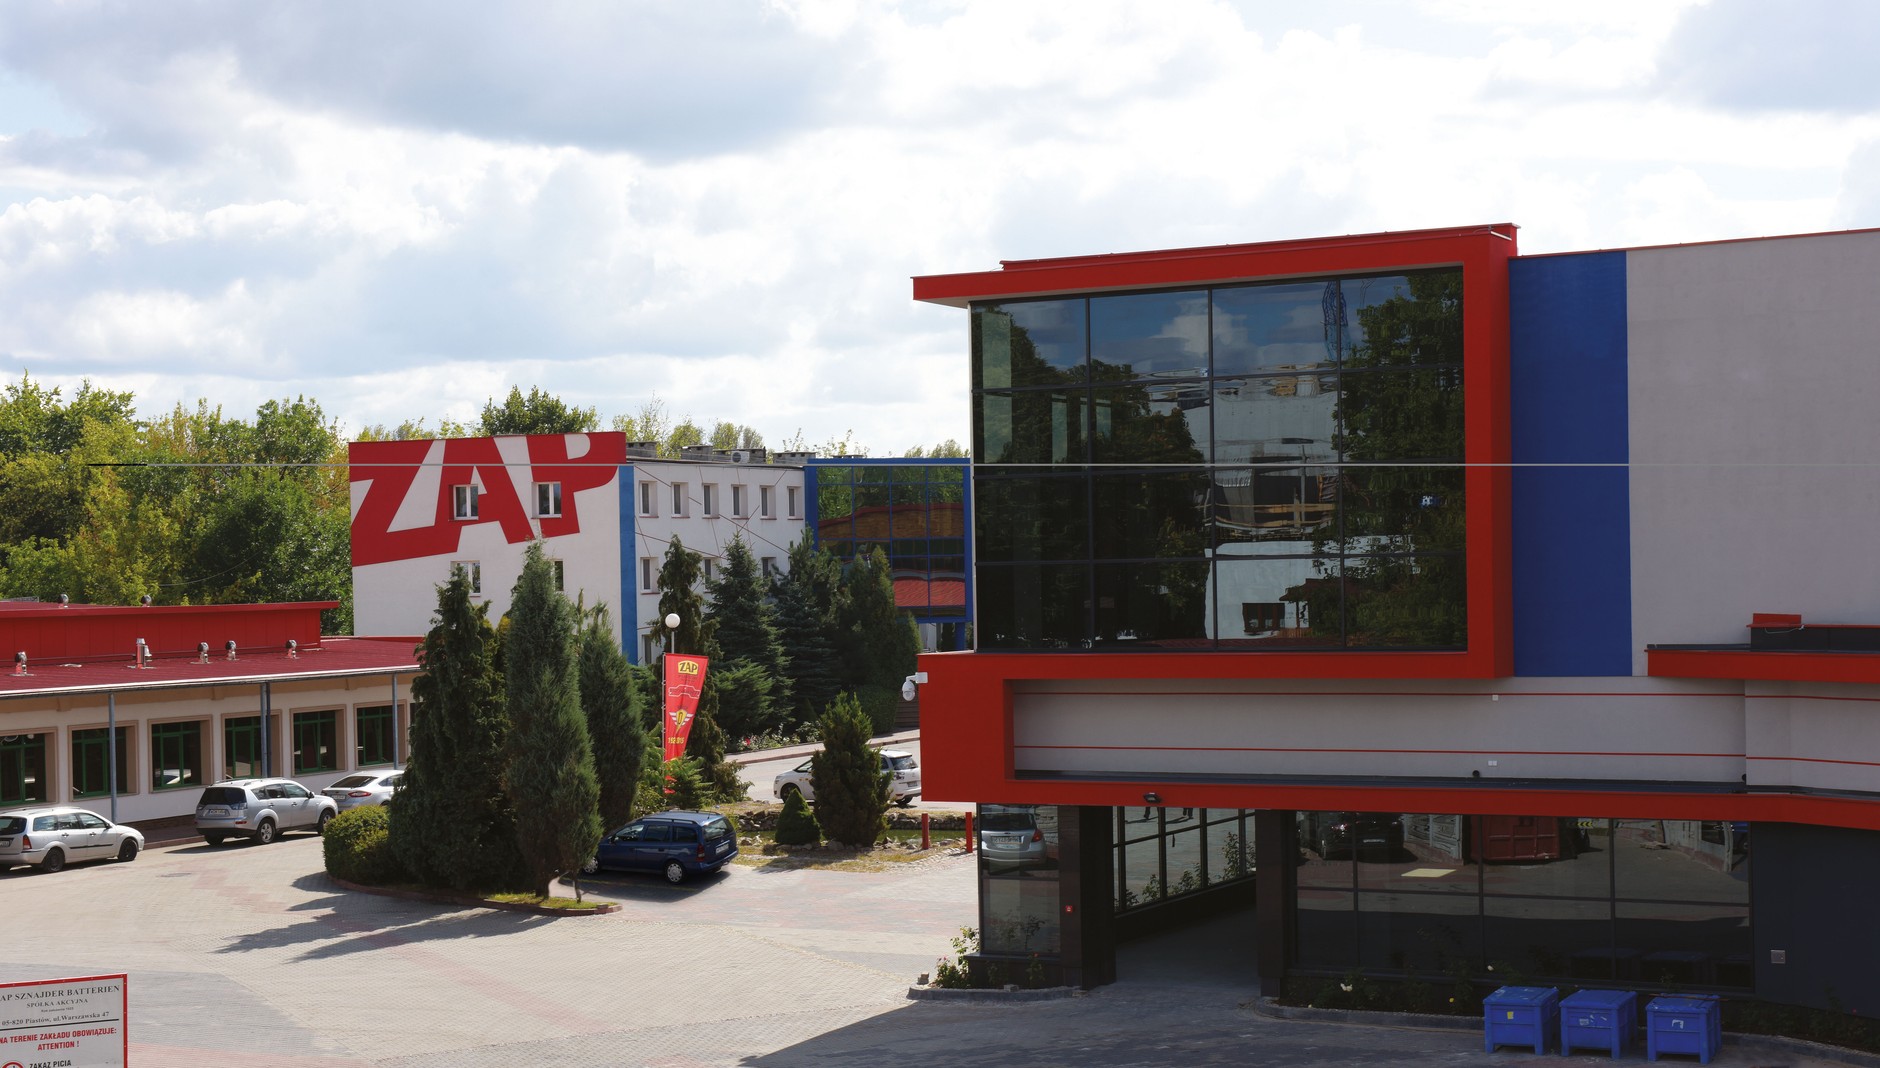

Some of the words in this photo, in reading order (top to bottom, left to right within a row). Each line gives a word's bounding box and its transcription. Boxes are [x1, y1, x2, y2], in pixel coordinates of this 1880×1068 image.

[349, 432, 625, 567] ZAP
[679, 661, 698, 672] ZAP
[15, 990, 64, 1000] SZNAJDER
[67, 985, 120, 996] BATTERIEN
[56, 998, 88, 1006] AKCYJNA
[10, 1034, 38, 1043] TERENIE
[40, 1031, 70, 1041] ZAKŁADU
[72, 1027, 117, 1037] OBOWIĄZUJE:
[37, 1041, 75, 1050] ATTENTION
